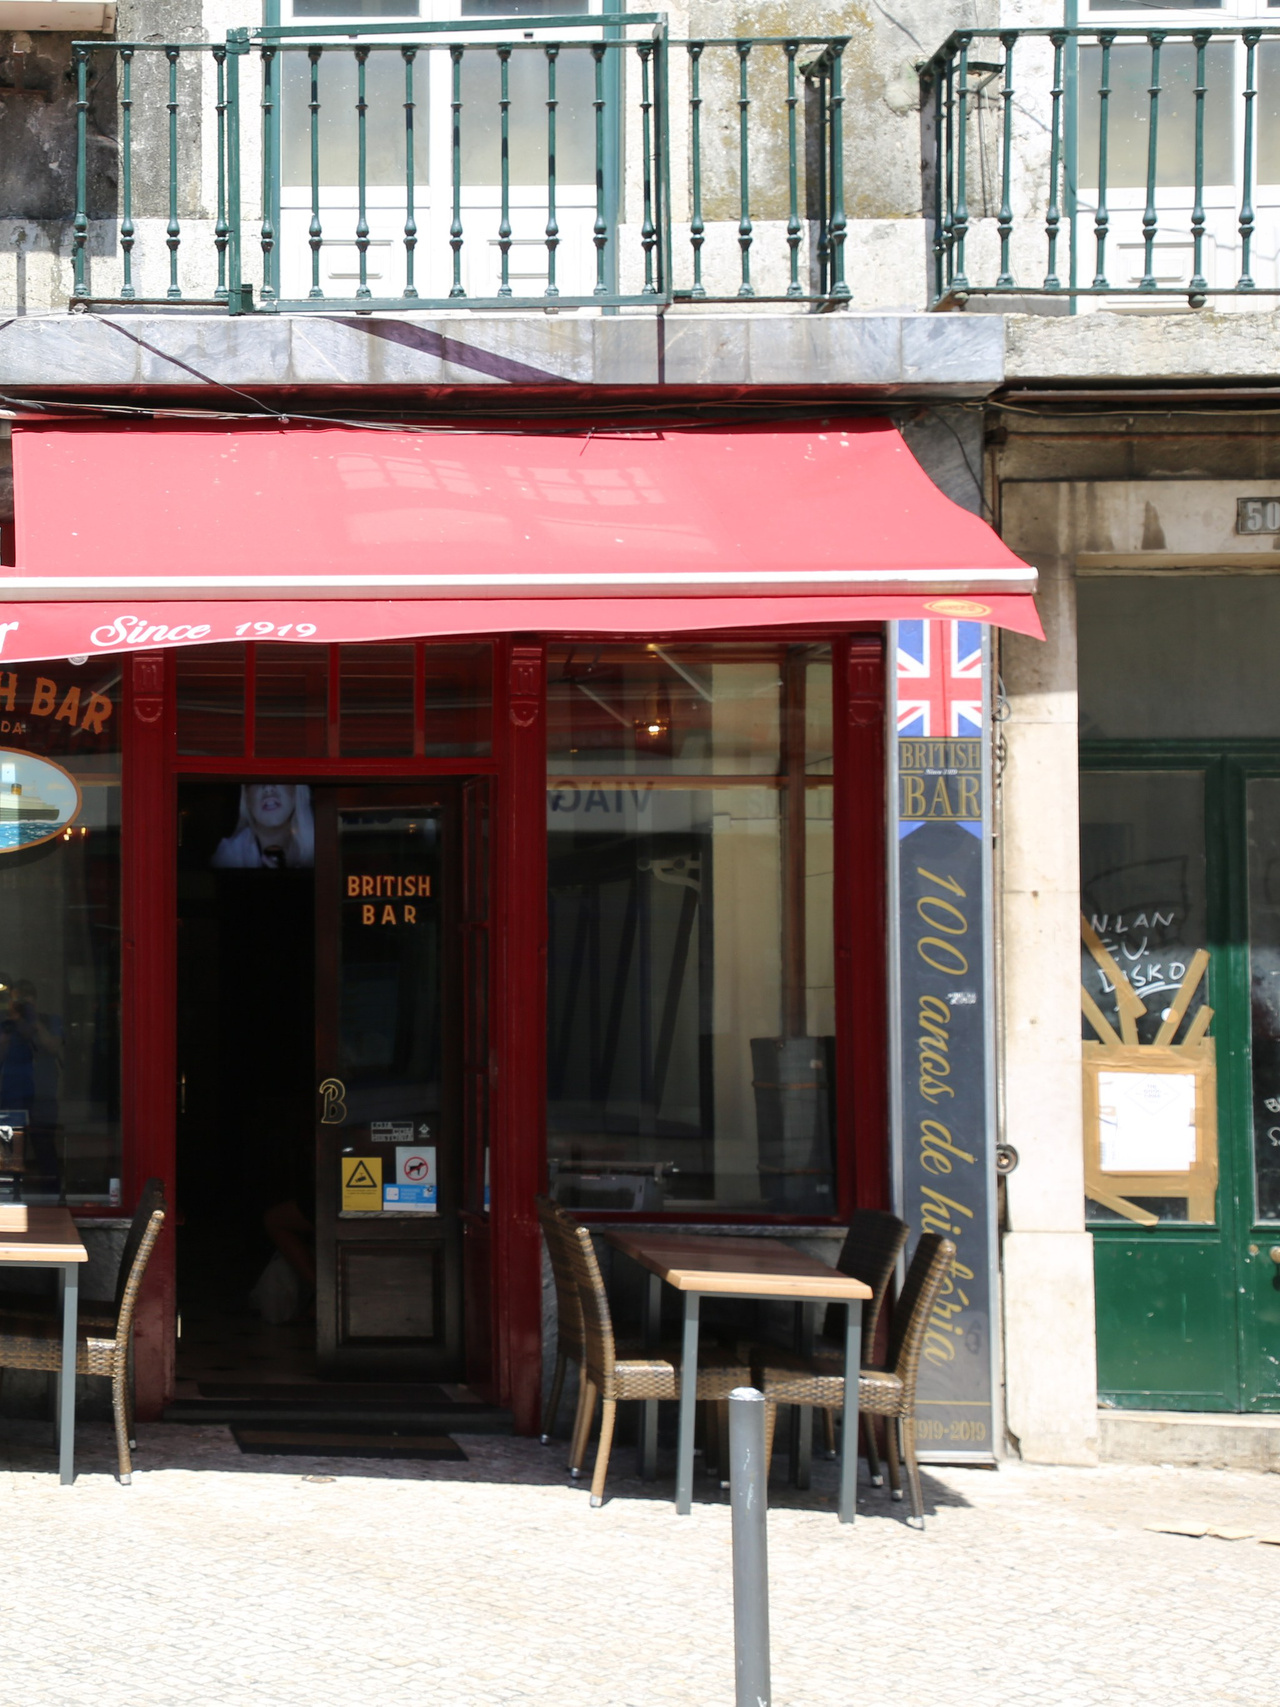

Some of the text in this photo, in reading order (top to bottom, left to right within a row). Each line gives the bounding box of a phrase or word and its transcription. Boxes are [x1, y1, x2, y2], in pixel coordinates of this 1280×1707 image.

[1247, 501, 1280, 531] 50
[90, 614, 212, 648] Since
[234, 620, 318, 640] 1919
[30, 676, 113, 735] BAR
[901, 742, 981, 769] BRITISH
[901, 775, 982, 817] BAR
[347, 875, 431, 897] BRITISH
[362, 904, 417, 926] BAR
[916, 866, 969, 976] 100
[916, 993, 956, 1106] anos
[319, 1078, 347, 1124] B
[920, 1117, 976, 1176] de
